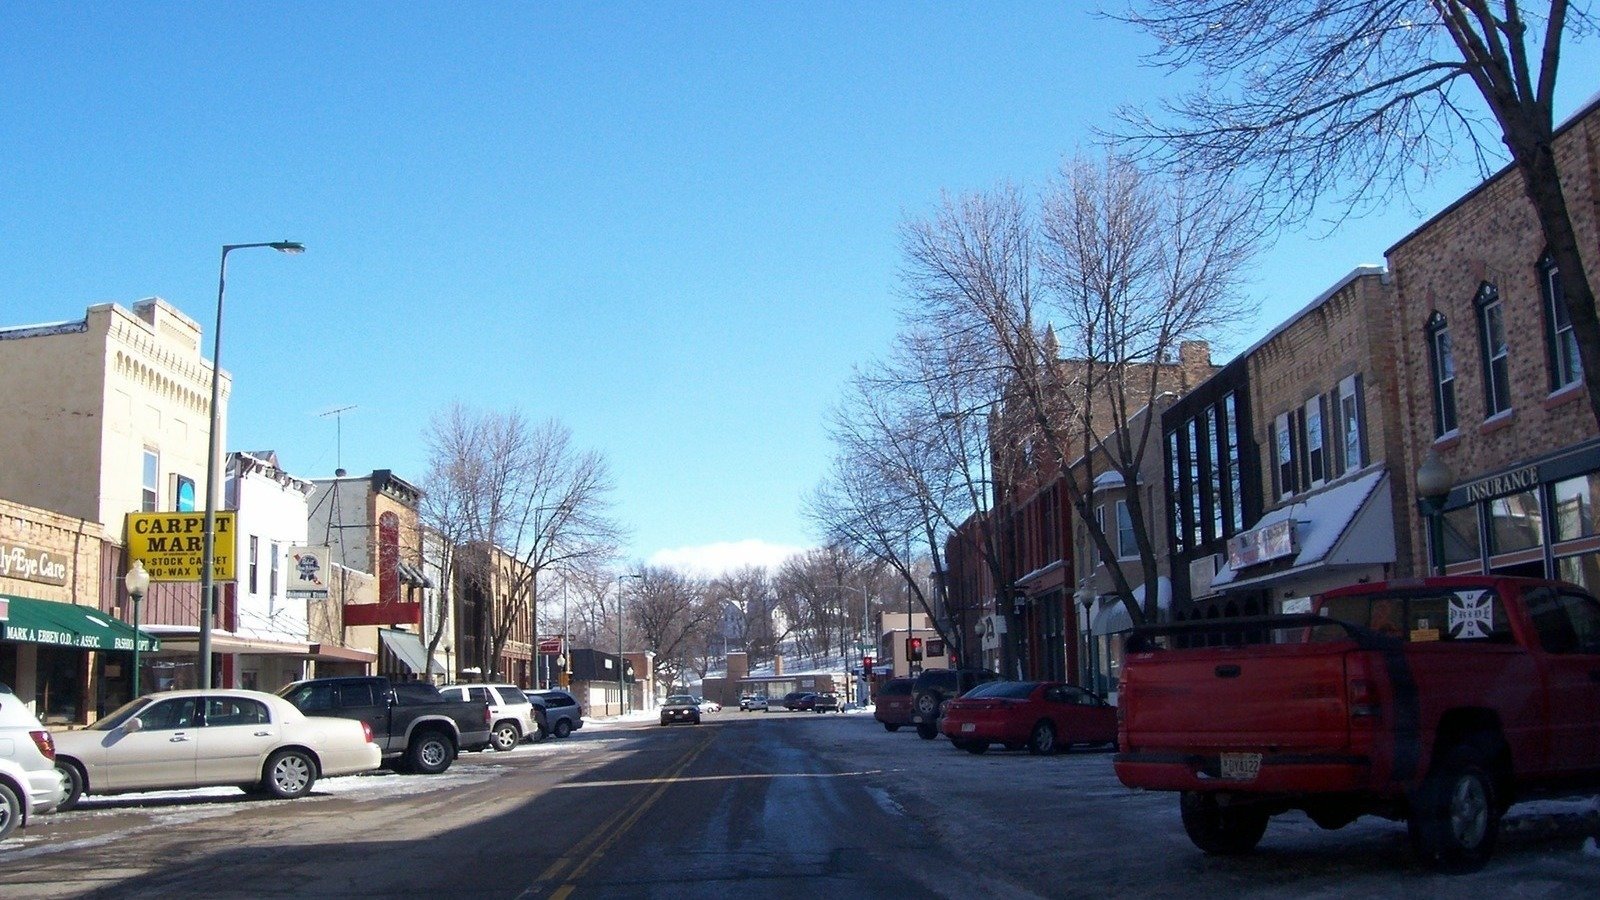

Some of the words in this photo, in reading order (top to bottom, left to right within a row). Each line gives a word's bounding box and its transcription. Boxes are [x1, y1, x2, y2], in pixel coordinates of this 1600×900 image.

[1466, 466, 1539, 502] INSURANCE
[147, 536, 217, 552] MAR
[12, 547, 38, 579] Eye
[39, 552, 65, 580] Care
[189, 556, 227, 566] CAET
[196, 566, 226, 576] VYL
[1450, 605, 1490, 624] PRIDE
[6, 626, 28, 641] MARK
[29, 629, 36, 642] A.
